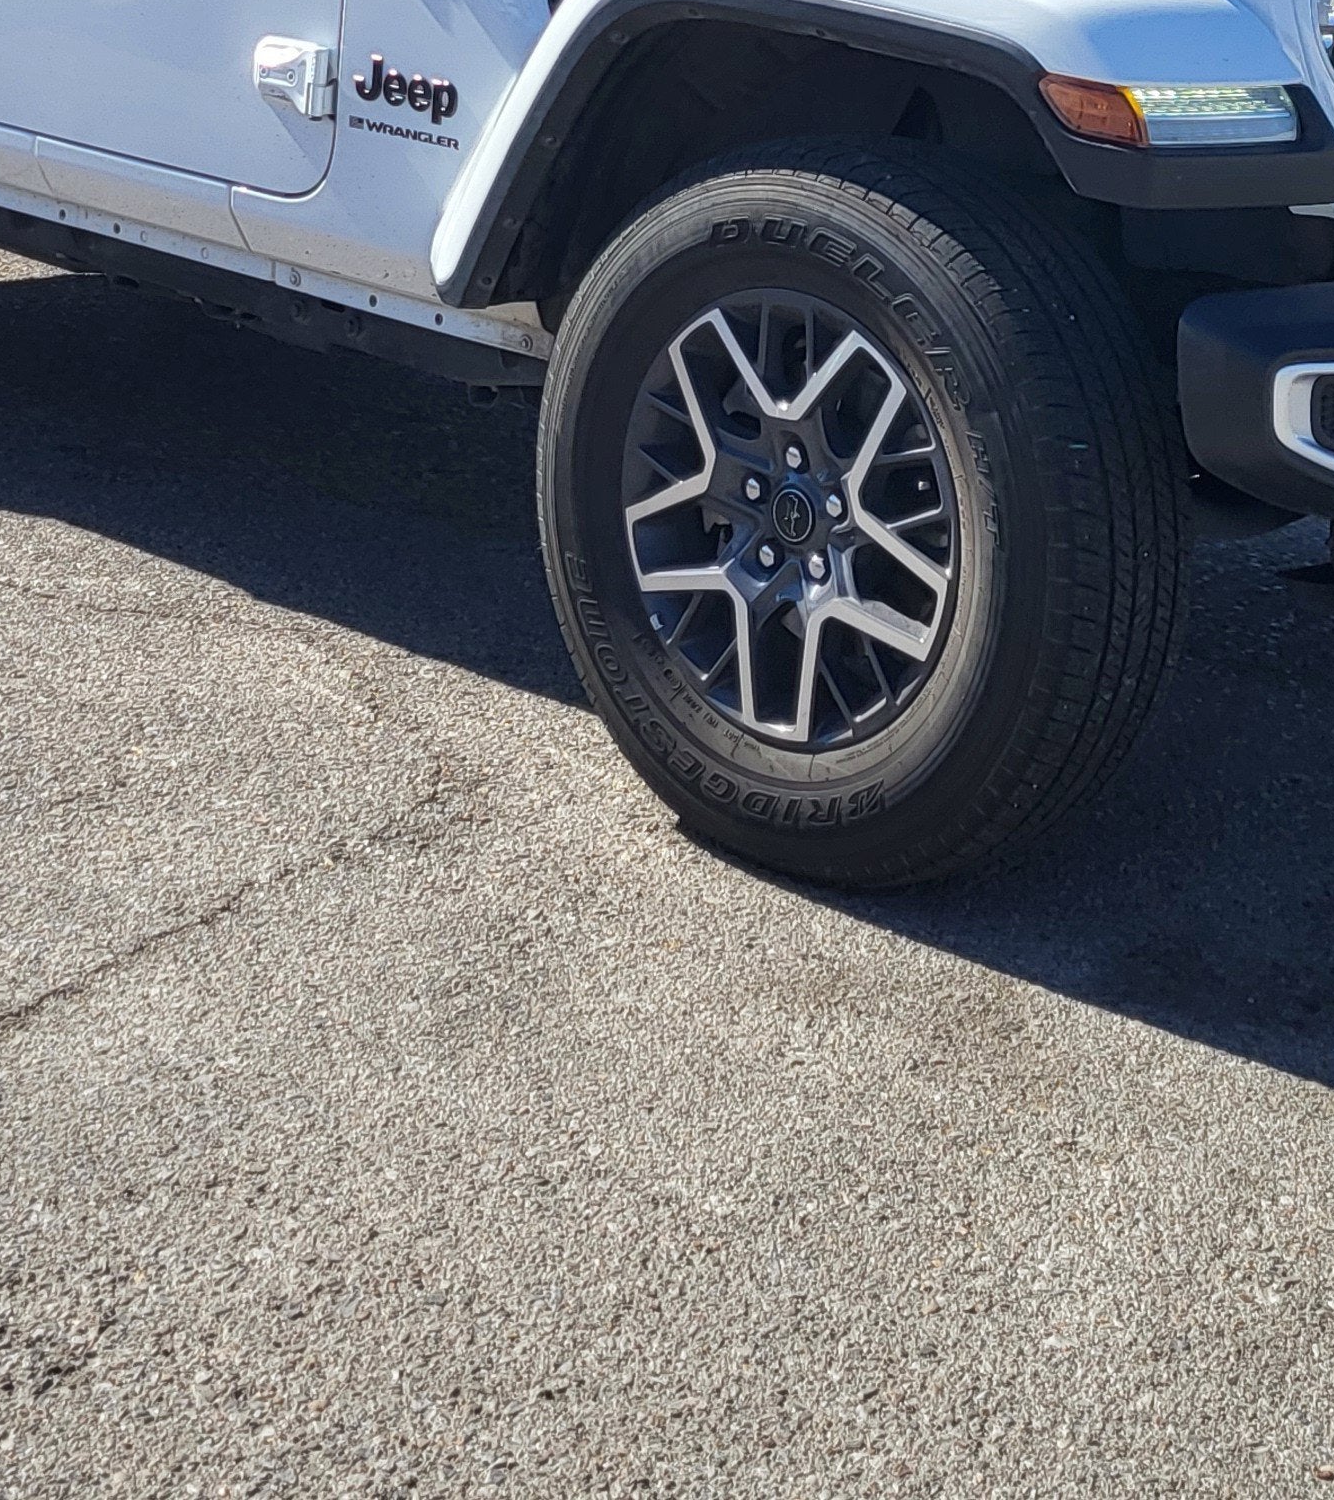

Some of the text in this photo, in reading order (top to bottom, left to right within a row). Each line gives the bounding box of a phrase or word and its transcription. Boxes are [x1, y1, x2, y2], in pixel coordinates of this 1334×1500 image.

[352, 53, 458, 126] Jeep
[365, 118, 460, 151] WRANGLER
[708, 213, 971, 412] DUELER
[564, 552, 887, 827] BRIDGESTONE
